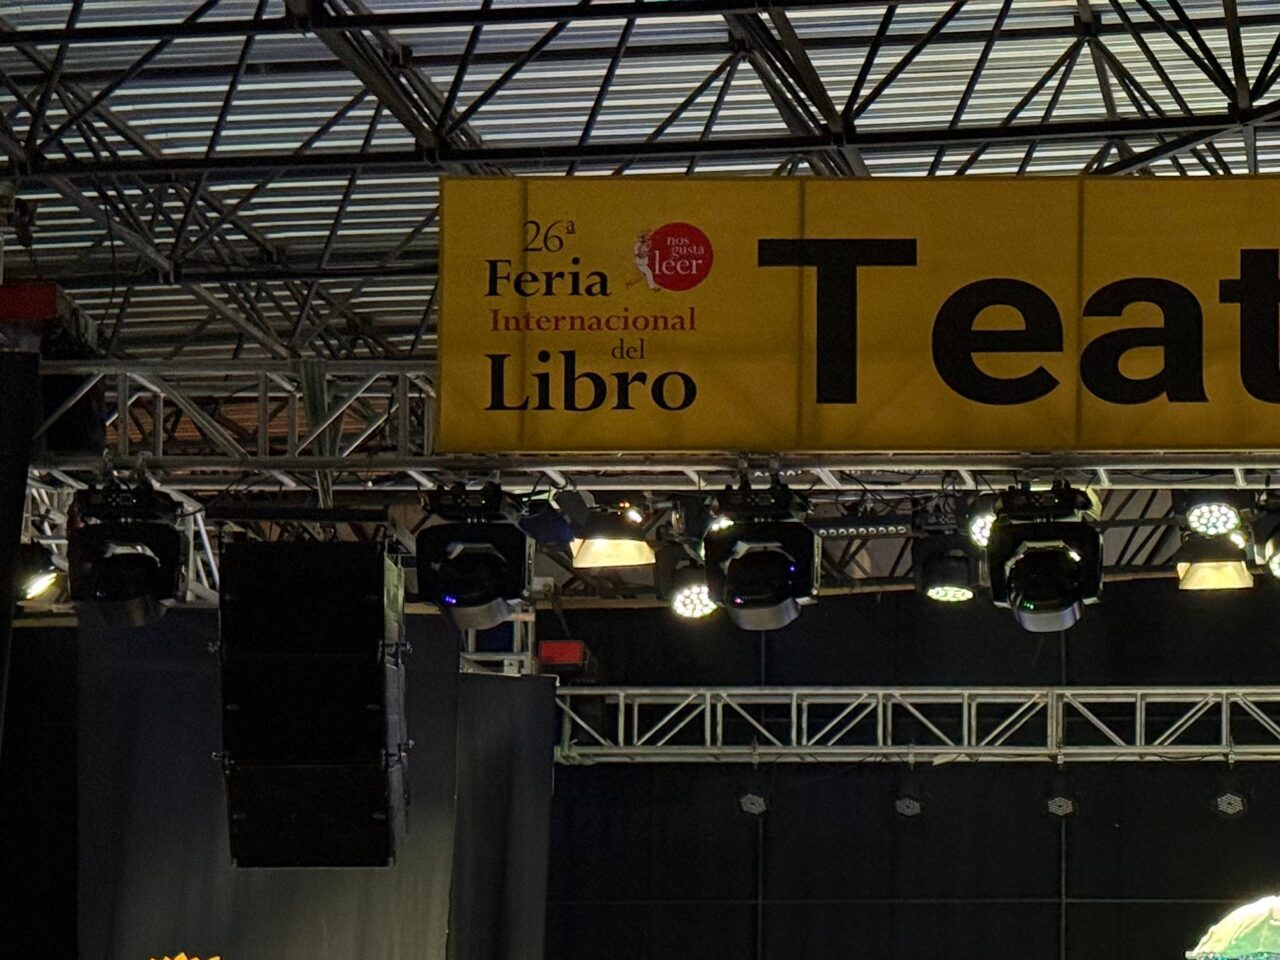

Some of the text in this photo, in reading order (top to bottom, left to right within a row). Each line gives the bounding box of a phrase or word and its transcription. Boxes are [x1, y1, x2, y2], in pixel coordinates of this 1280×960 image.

[667, 236, 690, 246] nos
[671, 244, 705, 258] gusta
[655, 250, 704, 275] leer
[484, 257, 612, 297] Feria
[490, 307, 697, 332] Internacional
[611, 338, 645, 360] del
[484, 350, 697, 411] Libro
